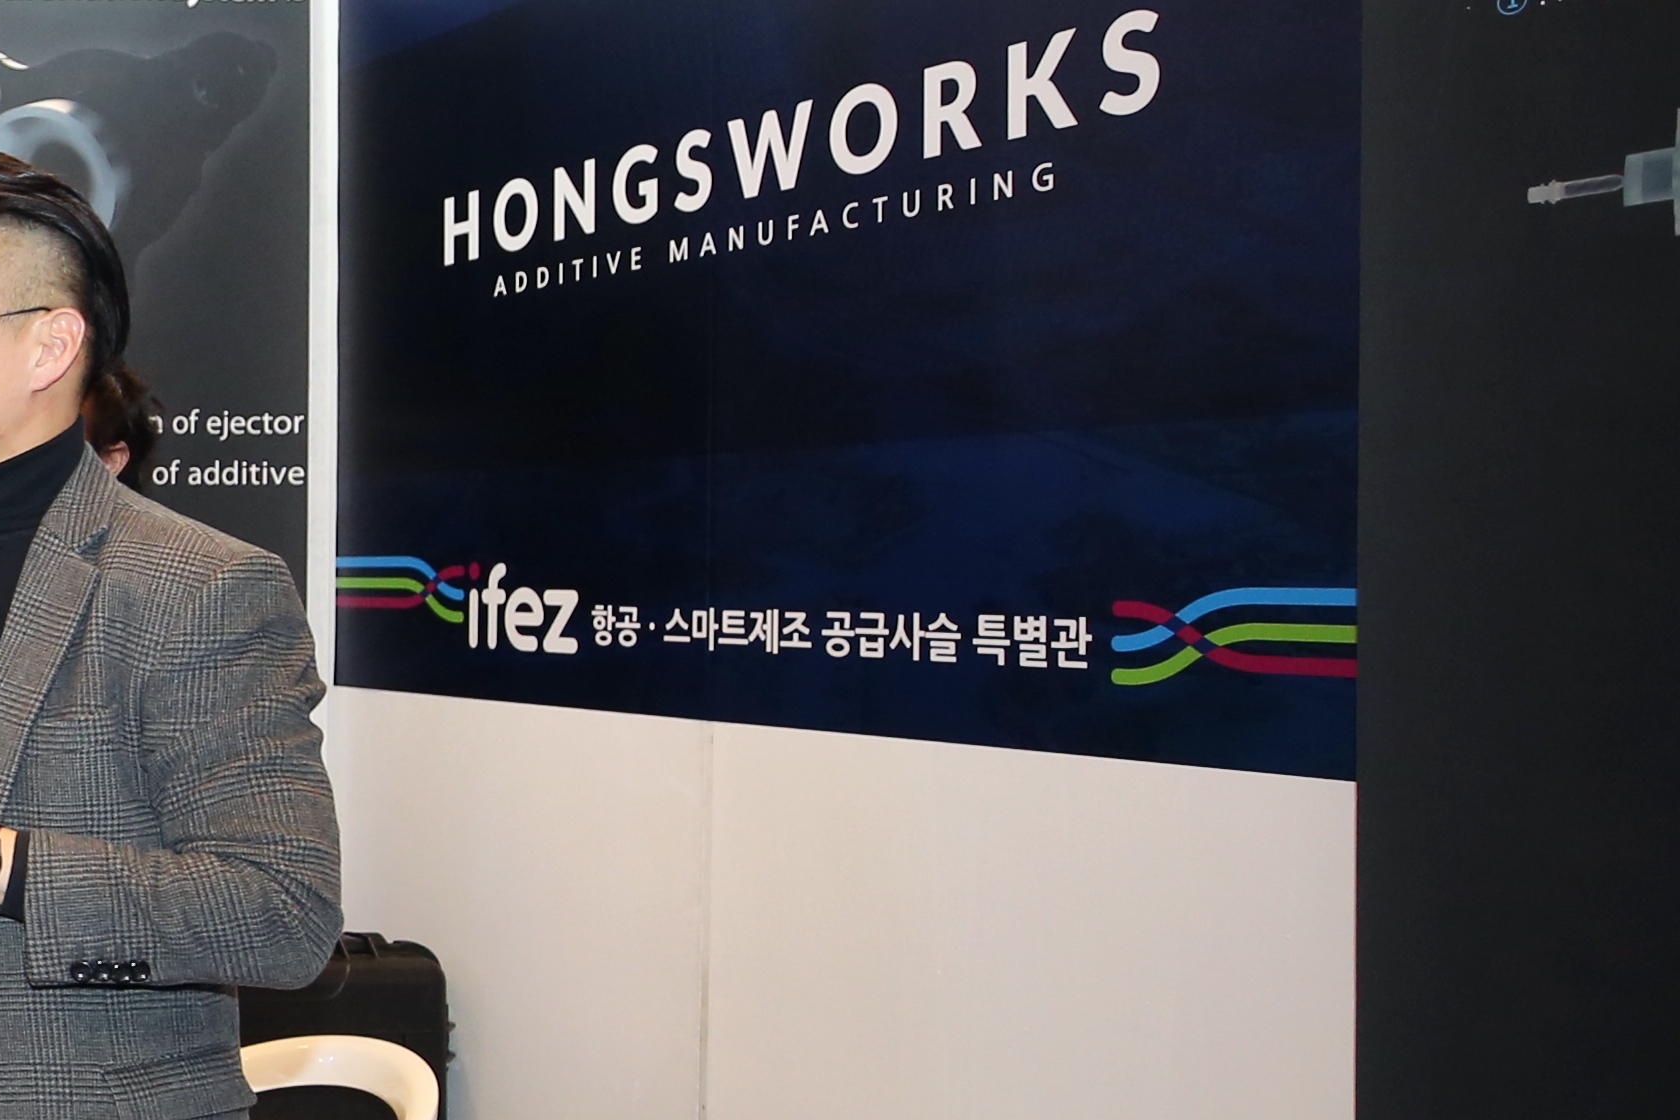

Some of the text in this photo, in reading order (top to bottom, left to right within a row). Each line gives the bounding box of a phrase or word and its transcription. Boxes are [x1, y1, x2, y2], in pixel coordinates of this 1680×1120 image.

[442, 8, 1161, 266] HONGSWORKS
[493, 161, 1057, 298] ADDITIVE MANUFACTURING
[172, 408, 200, 435] of
[206, 408, 305, 442] ejector
[152, 458, 306, 486] of additive
[467, 561, 579, 655] ifez
[820, 610, 962, 663] 공급사슬
[972, 613, 1093, 669] 특별관
